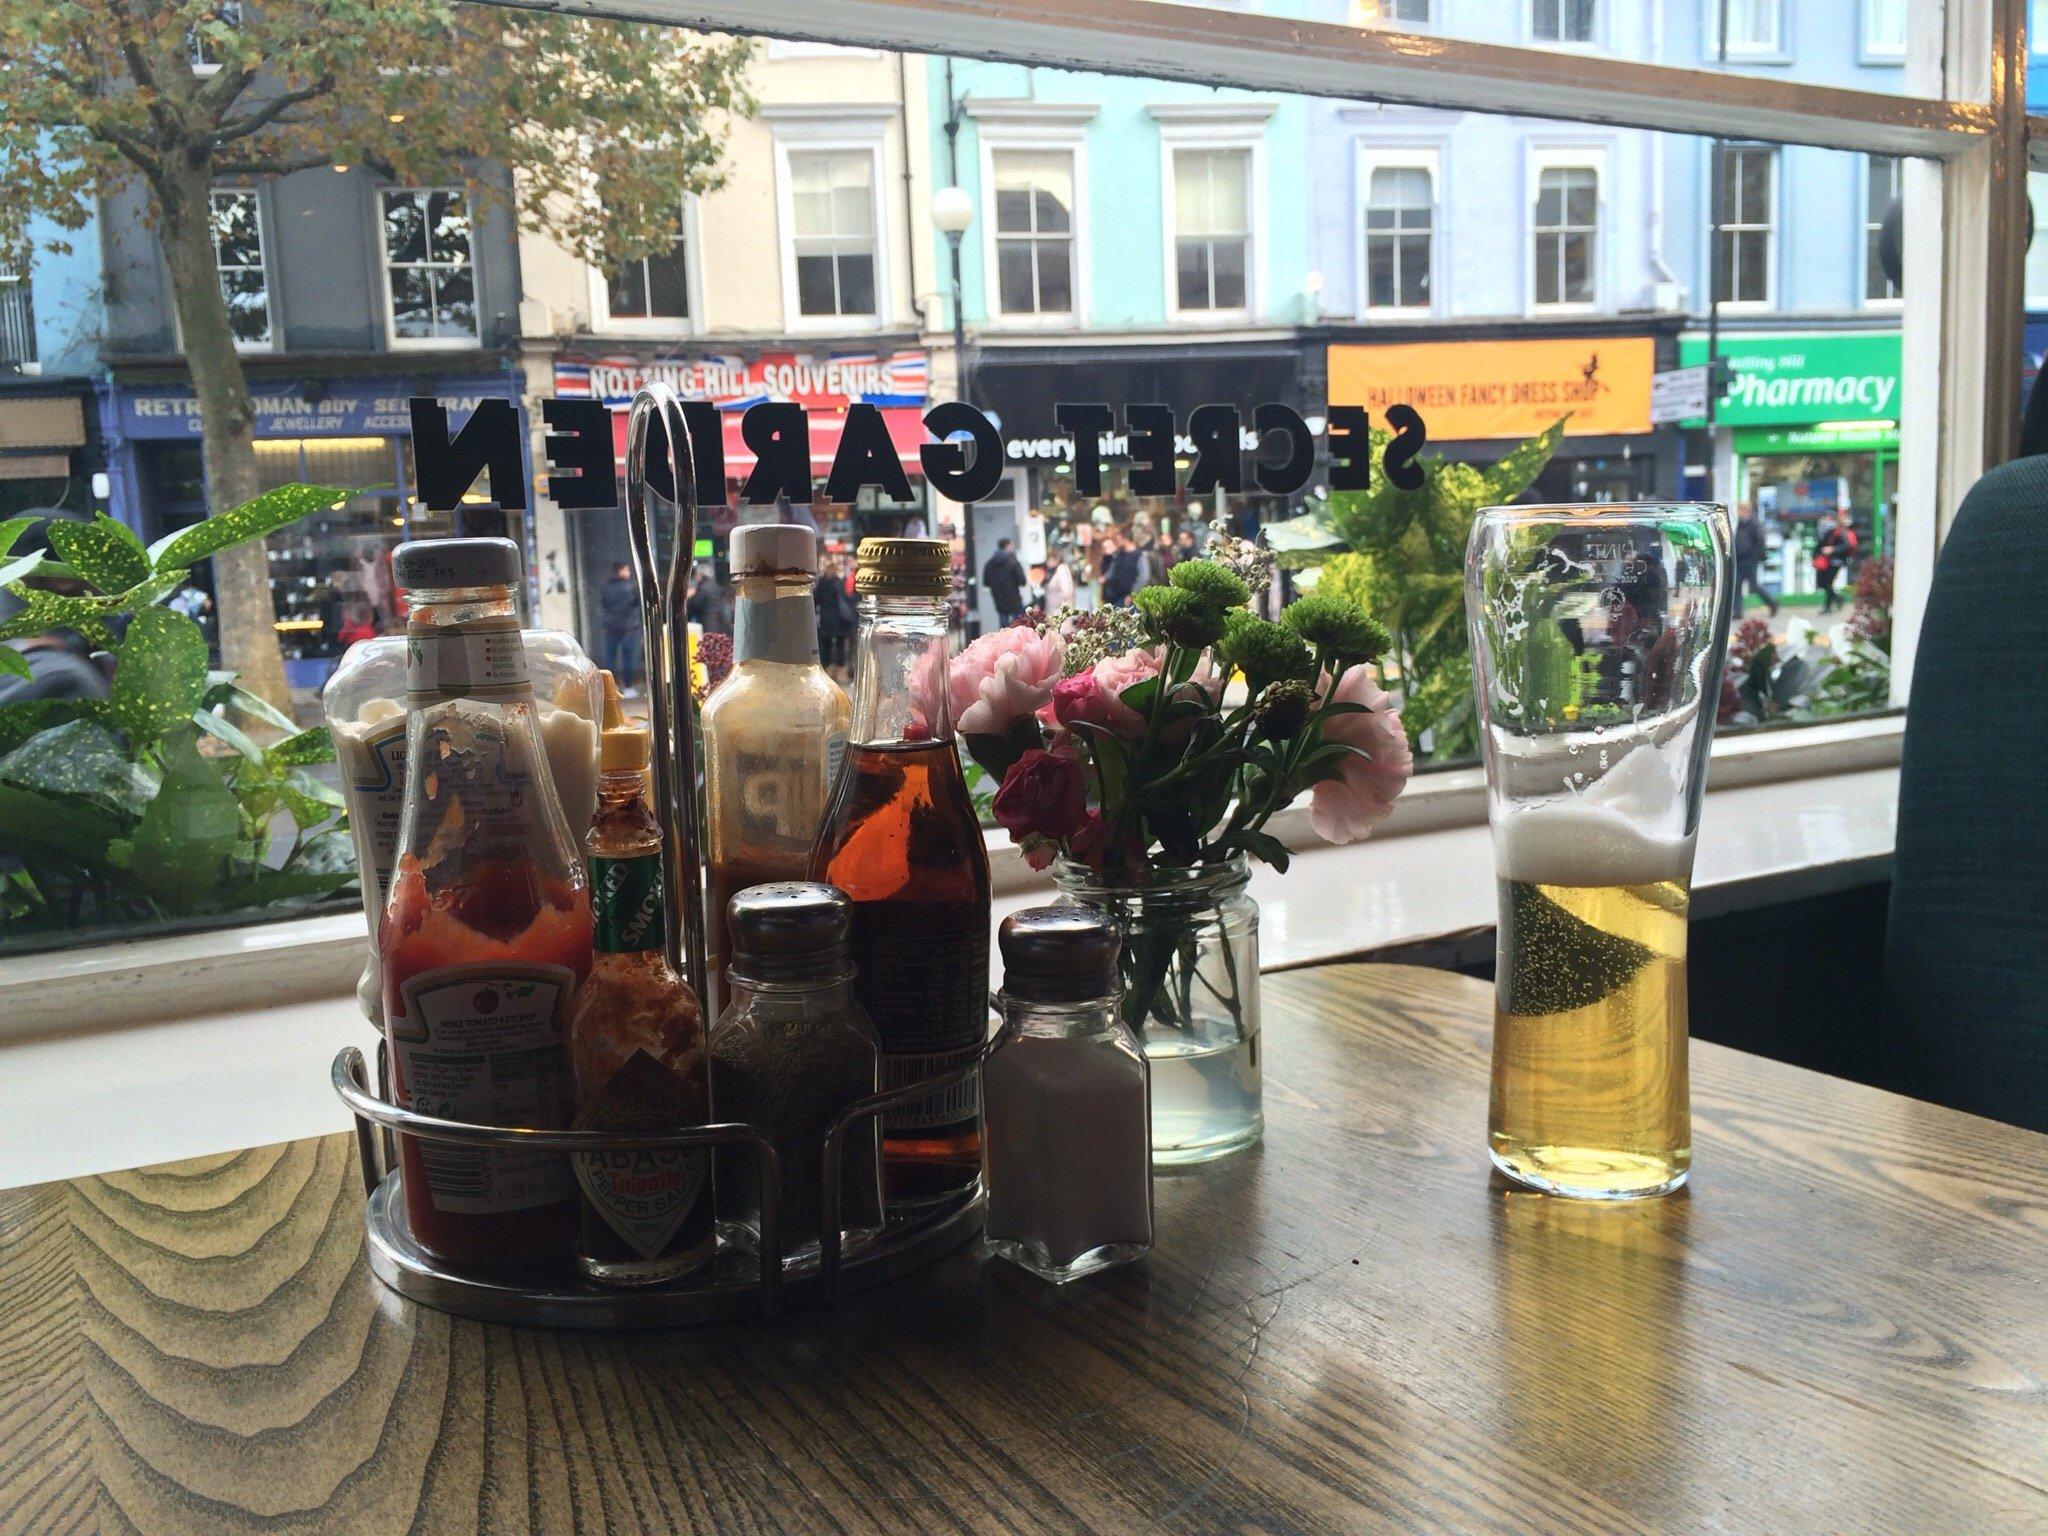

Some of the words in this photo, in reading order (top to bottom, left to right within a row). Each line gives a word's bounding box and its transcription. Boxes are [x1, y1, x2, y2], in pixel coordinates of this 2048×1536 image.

[590, 365, 694, 398] NOTTING
[703, 364, 757, 396] HILL
[763, 362, 893, 395] SOUVENIRS
[1460, 384, 1507, 405] FANCY
[1512, 382, 1556, 403] DRESS
[1562, 380, 1598, 401] SHOP
[134, 398, 202, 417] RETR
[318, 398, 357, 414] BUY
[374, 397, 410, 412] SEL
[269, 416, 344, 431] JEWELLERY
[440, 1018, 463, 1030] HEINZ
[466, 1017, 498, 1028] TOMATO
[499, 1012, 537, 1026] KETCHUP
